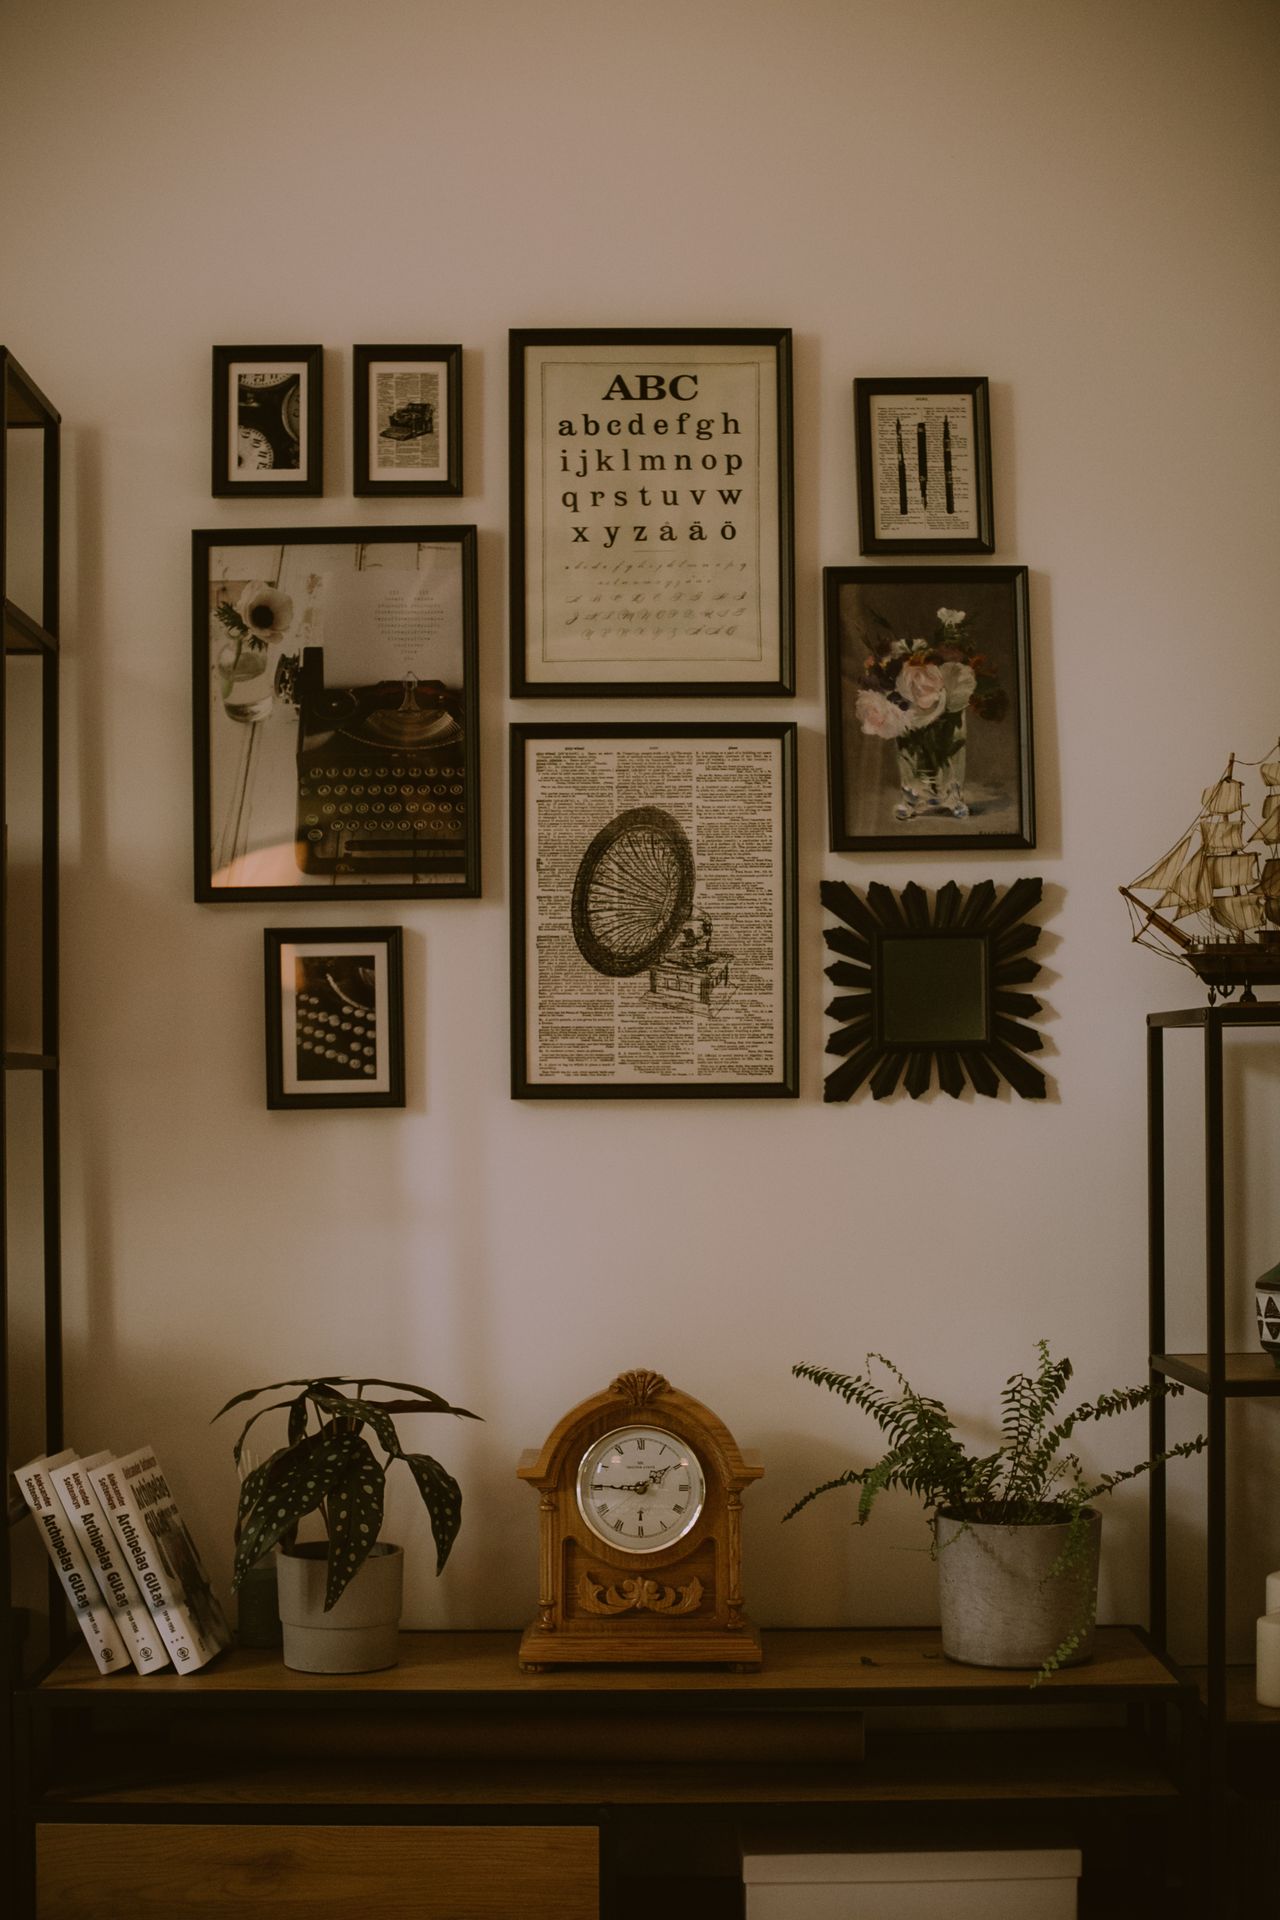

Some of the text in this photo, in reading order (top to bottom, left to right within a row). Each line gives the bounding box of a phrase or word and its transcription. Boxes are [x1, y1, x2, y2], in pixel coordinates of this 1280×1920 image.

[602, 374, 698, 401] ABC
[34, 1473, 50, 1507] Aleksander
[72, 1472, 90, 1506] Aleksander
[107, 1473, 125, 1507] Aleksander
[42, 1513, 73, 1572] Archipelag
[81, 1512, 113, 1572] Archipelag
[117, 1513, 150, 1572] Archipelag
